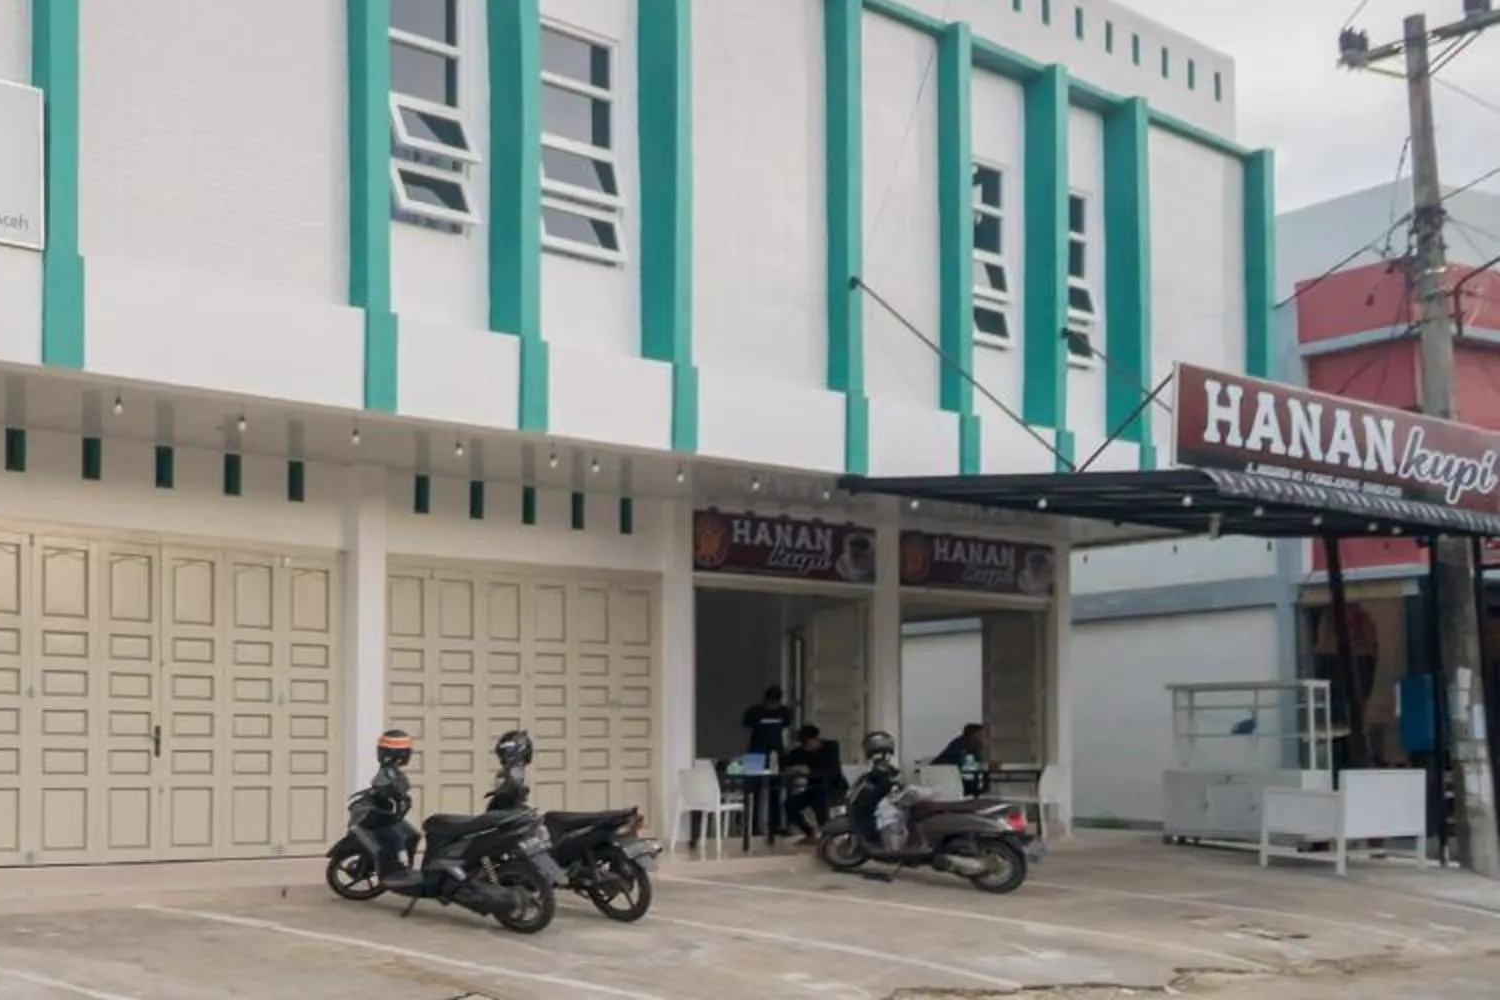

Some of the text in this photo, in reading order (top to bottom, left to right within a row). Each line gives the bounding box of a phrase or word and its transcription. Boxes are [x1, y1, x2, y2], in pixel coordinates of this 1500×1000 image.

[1203, 379, 1398, 474] HANAN
[1399, 425, 1498, 505] kupi
[732, 519, 833, 555] HANAN
[933, 536, 1016, 569] HANAN
